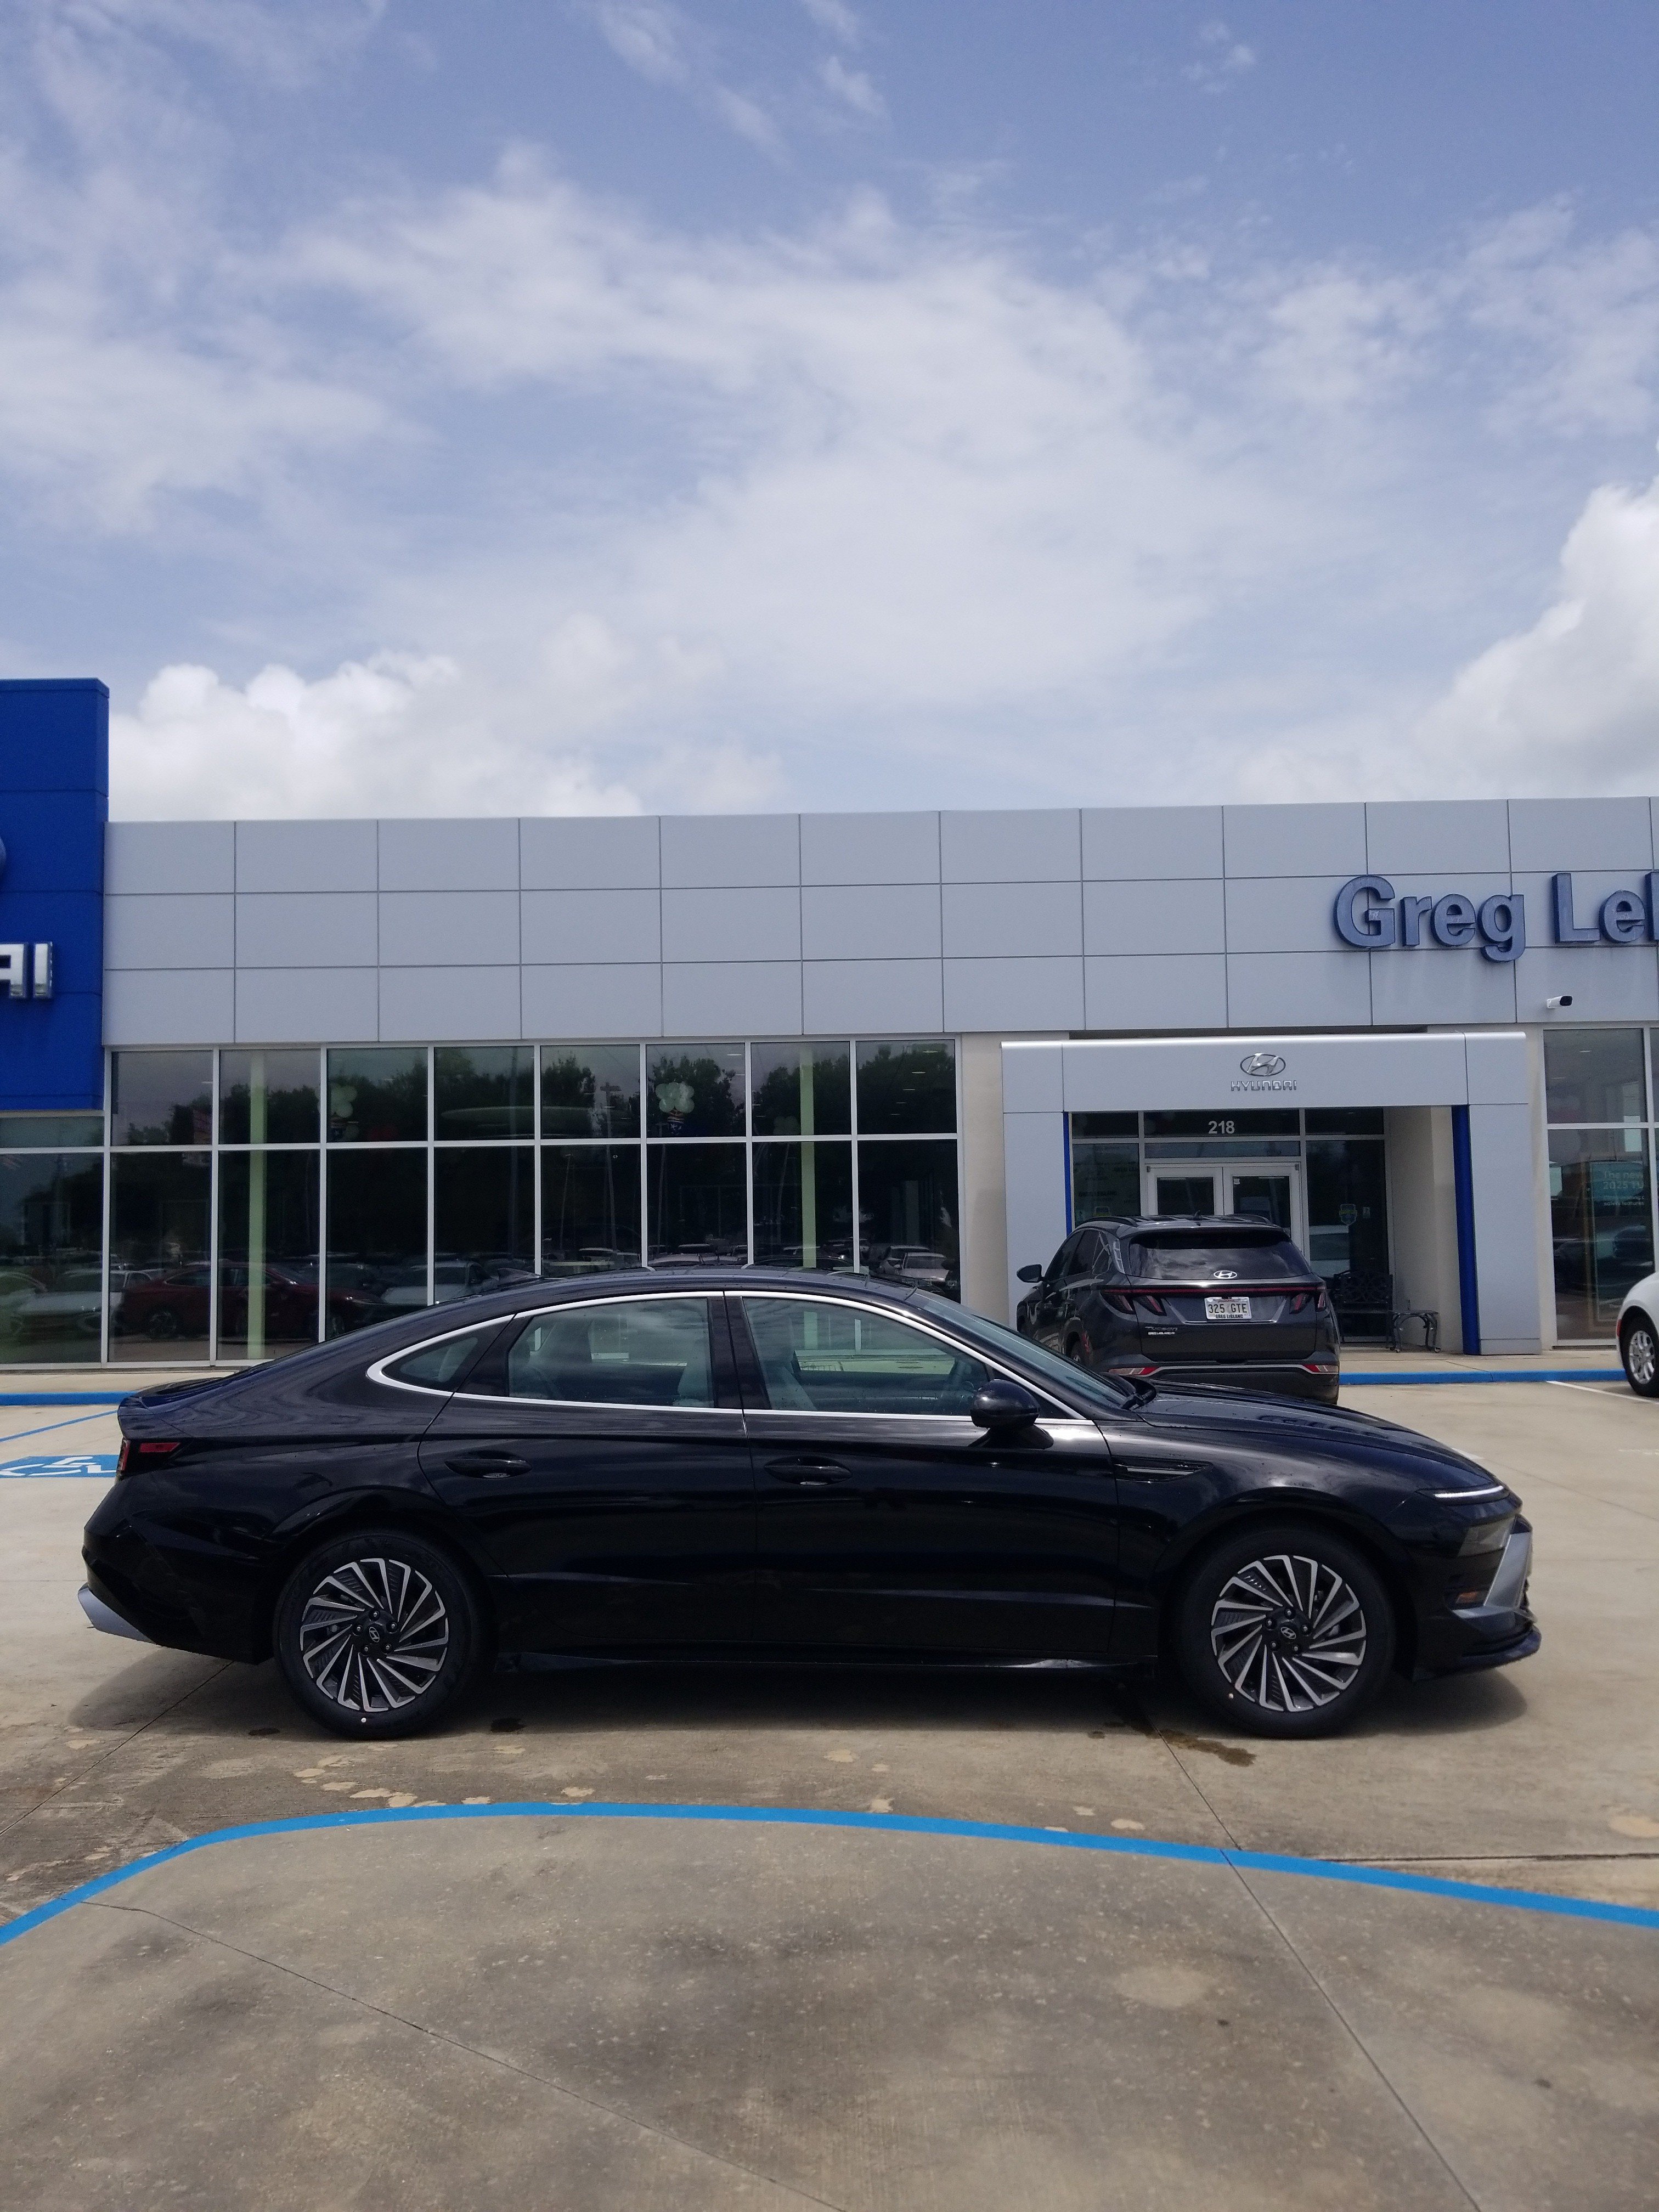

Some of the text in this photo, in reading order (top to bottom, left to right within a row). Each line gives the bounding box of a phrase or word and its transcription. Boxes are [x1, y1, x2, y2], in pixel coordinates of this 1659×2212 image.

[1334, 875, 1526, 963] Greg
[1231, 1080, 1297, 1091] HYUNDAI
[1209, 1120, 1235, 1134] 218
[1208, 1304, 1248, 1313] 325 GTE
